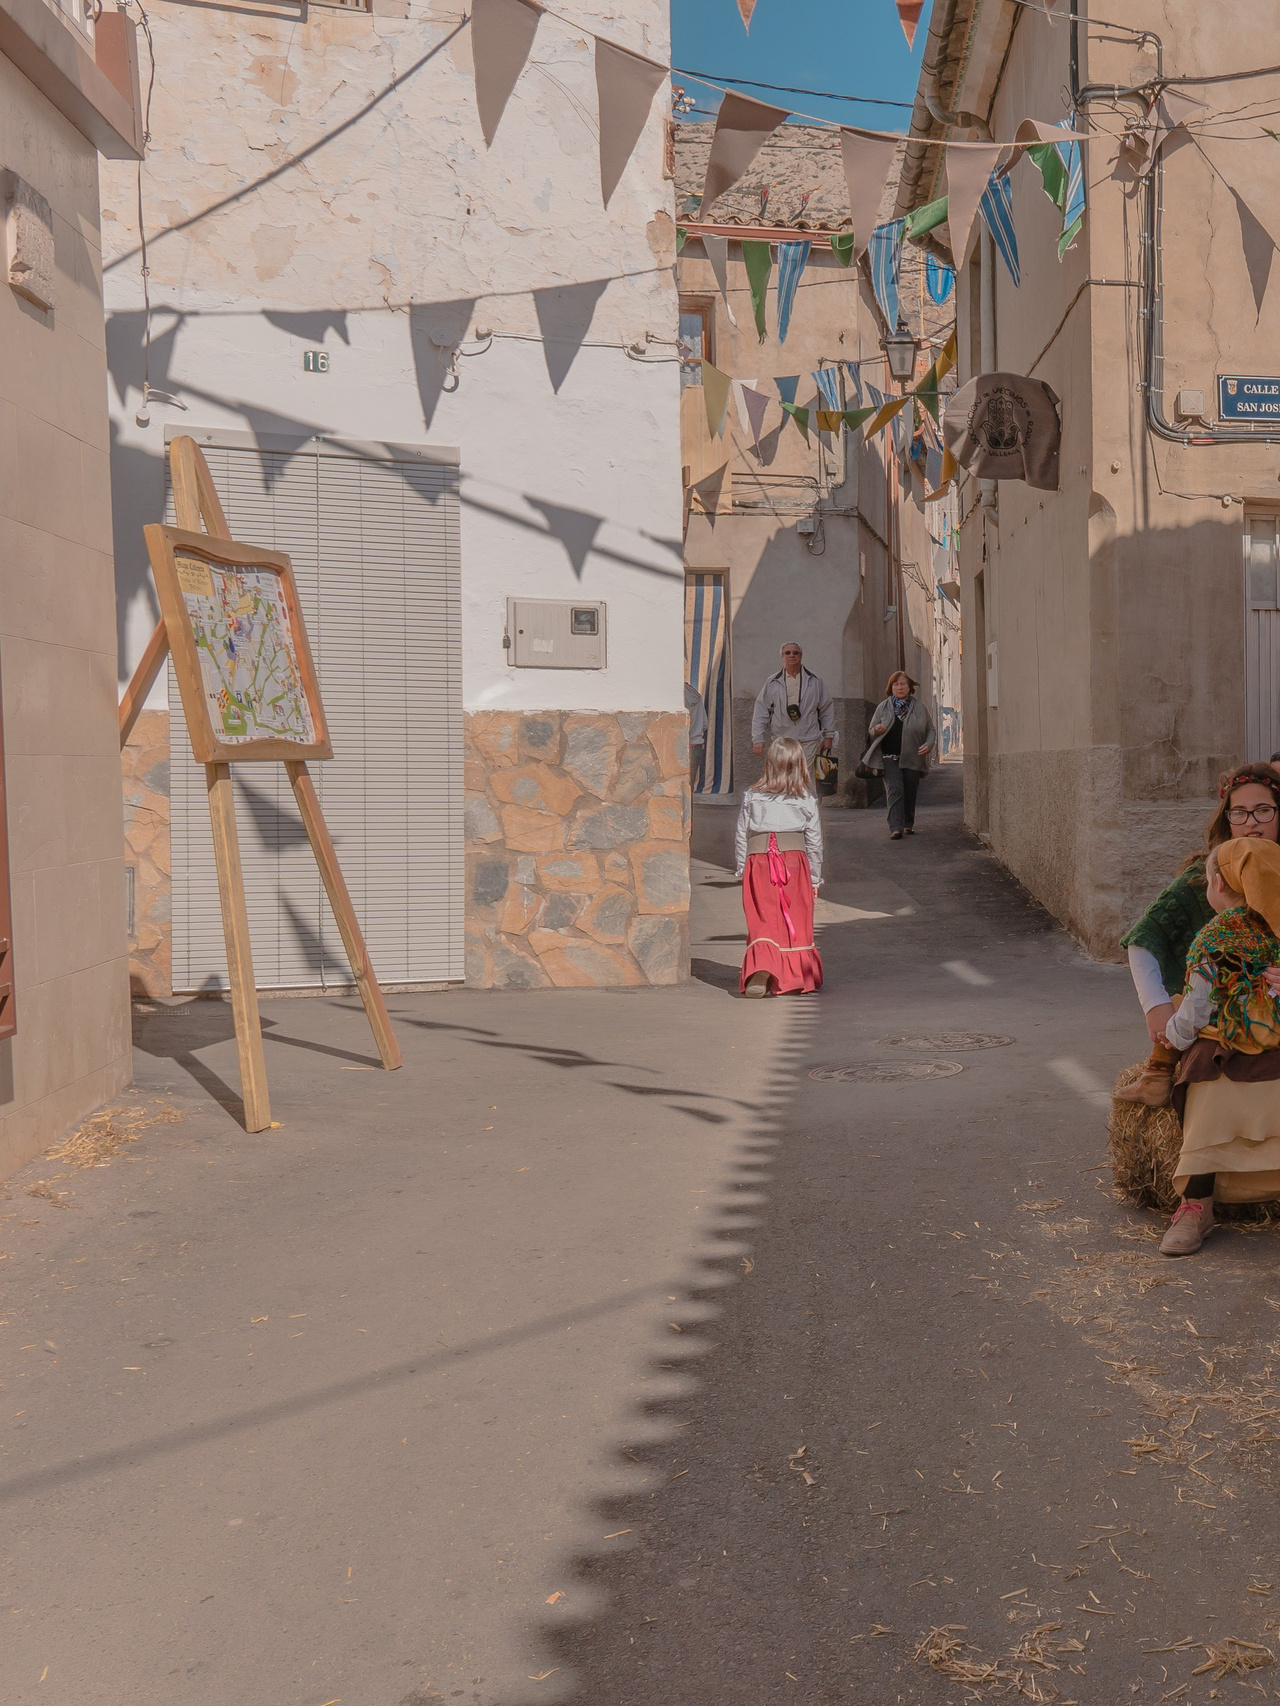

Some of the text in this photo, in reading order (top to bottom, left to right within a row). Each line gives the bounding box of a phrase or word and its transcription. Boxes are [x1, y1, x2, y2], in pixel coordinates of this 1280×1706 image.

[306, 351, 329, 372] 16
[1243, 384, 1279, 395] CALLE
[991, 387, 1029, 409] VECINOS
[1236, 402, 1258, 412] SAN
